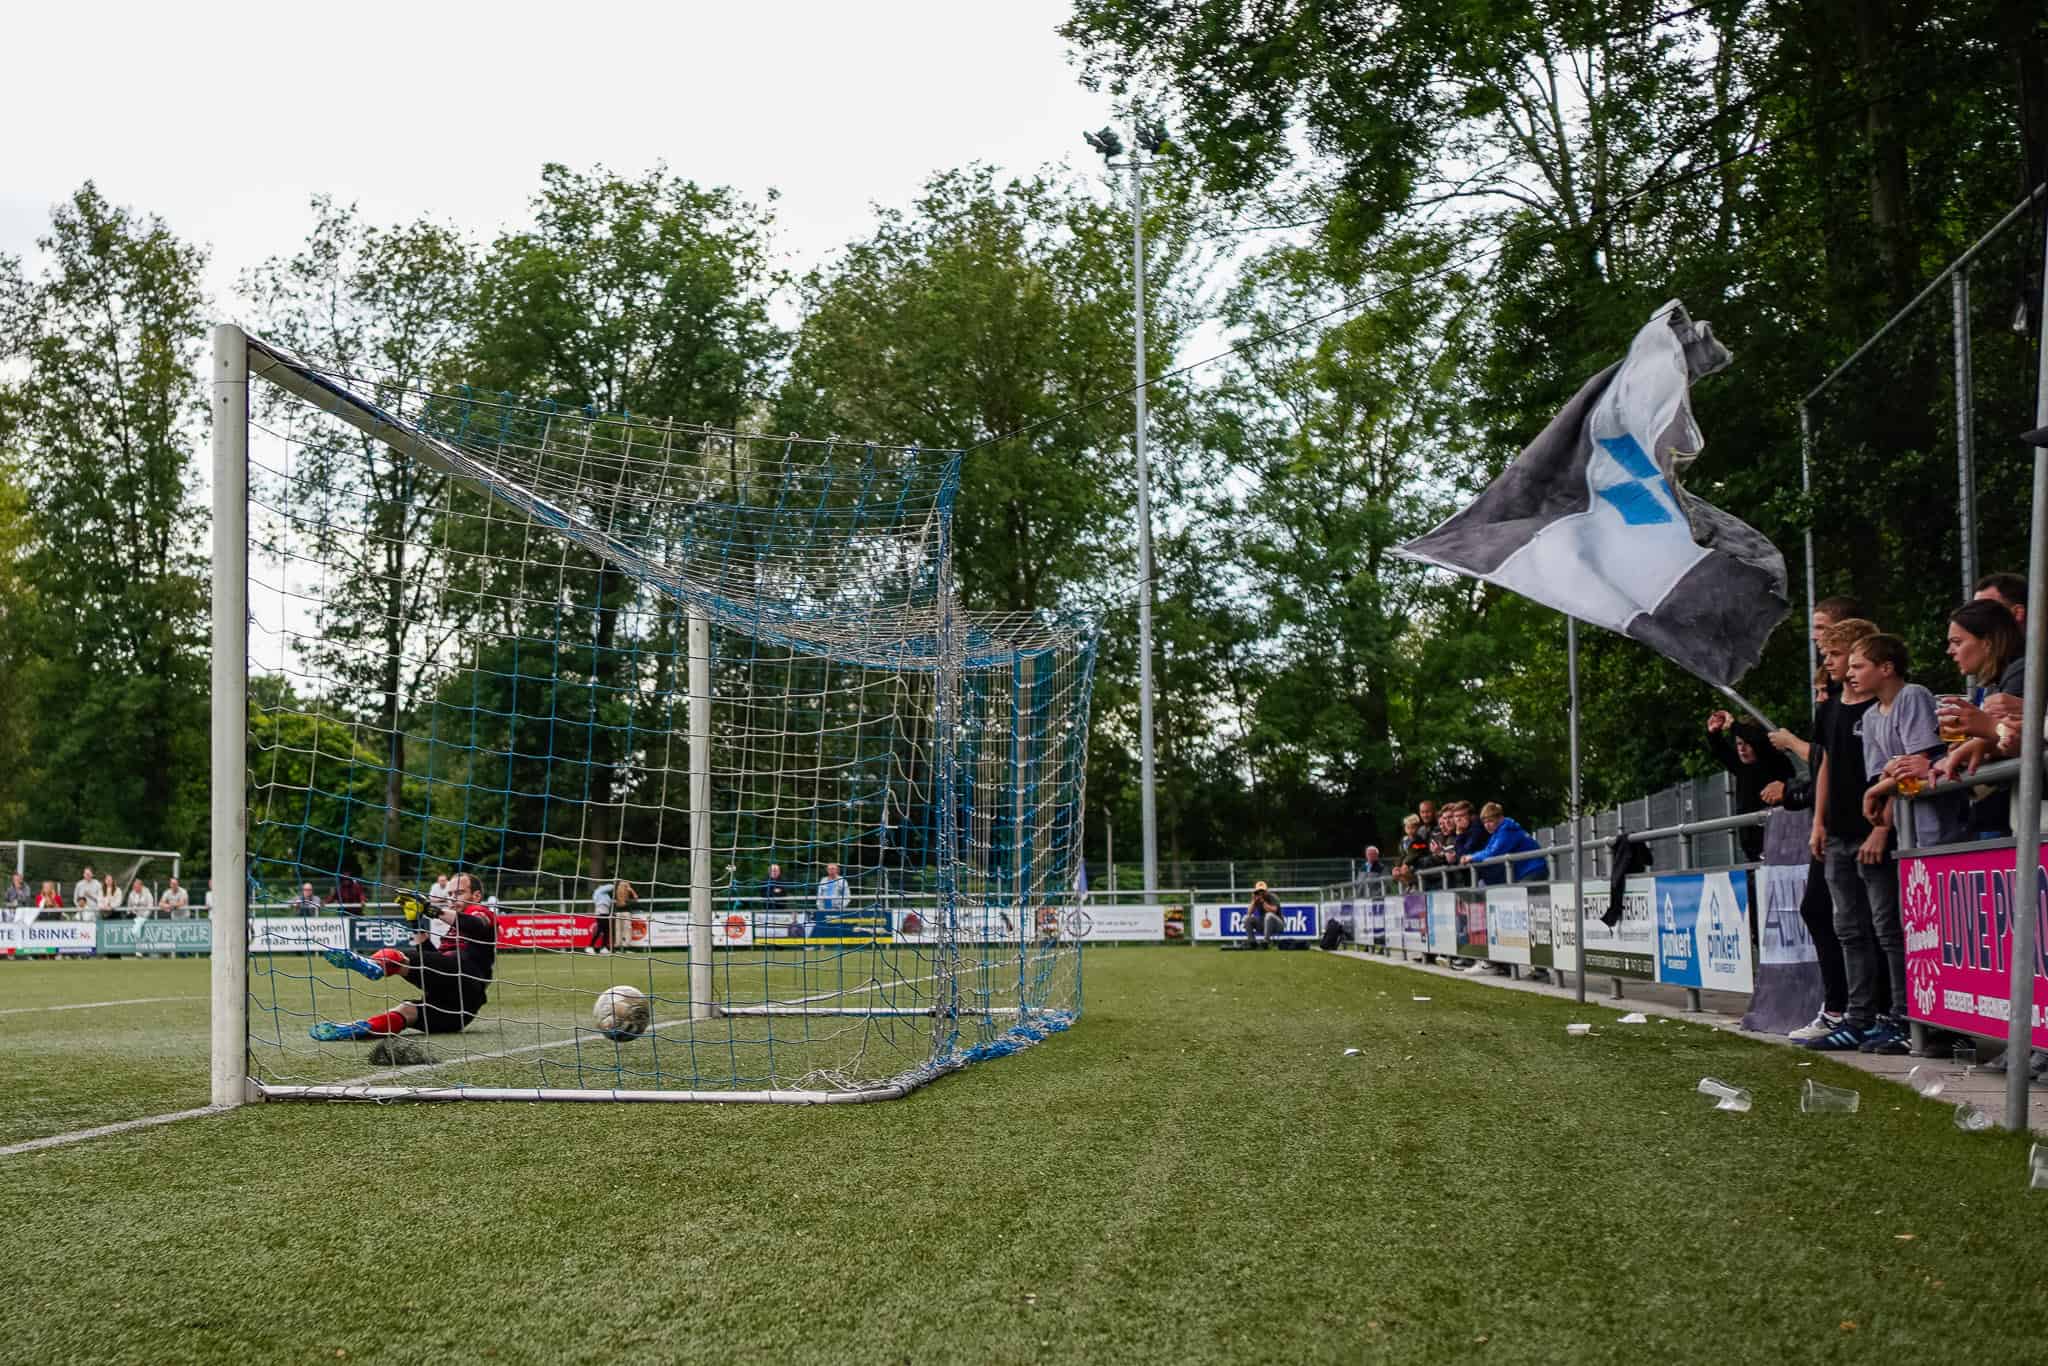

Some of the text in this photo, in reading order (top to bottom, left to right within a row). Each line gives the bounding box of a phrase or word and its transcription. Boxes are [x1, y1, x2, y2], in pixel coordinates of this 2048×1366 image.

[29, 928, 77, 940] BRINKE
[1936, 870, 1992, 971] LOVE
[1707, 923, 1741, 968] pinkert
